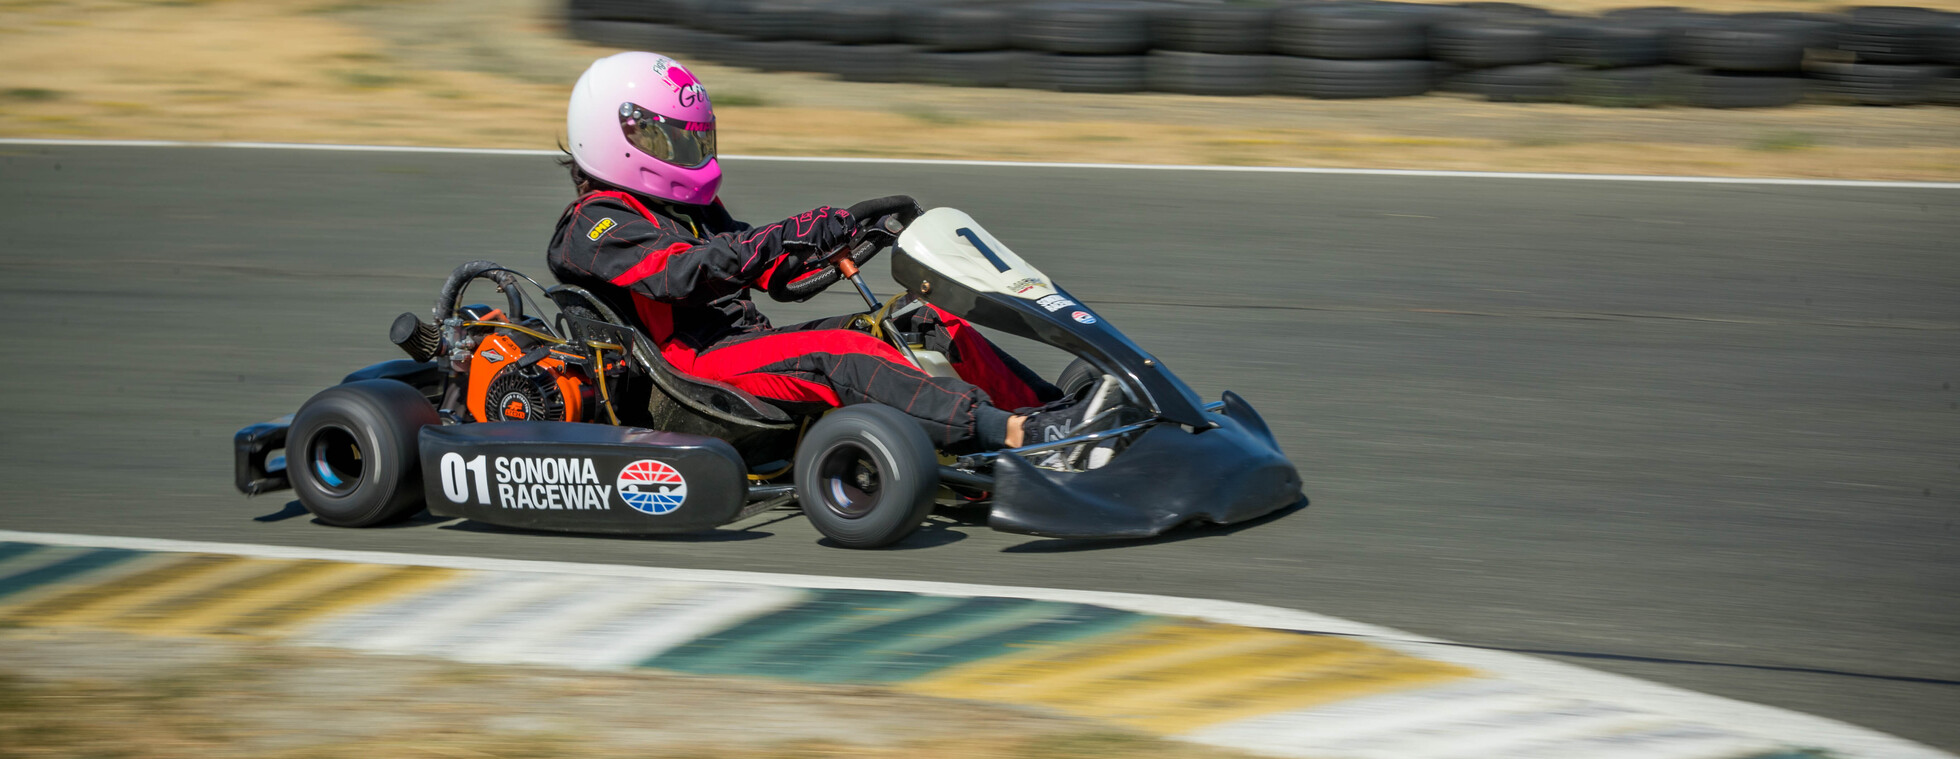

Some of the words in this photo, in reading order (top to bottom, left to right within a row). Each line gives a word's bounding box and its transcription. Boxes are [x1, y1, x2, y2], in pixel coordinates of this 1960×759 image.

[589, 218, 612, 239] OMP
[956, 227, 1012, 273] 1
[440, 452, 492, 505] 01
[495, 456, 600, 485] SONOMA
[498, 483, 612, 510] RACEWAY
